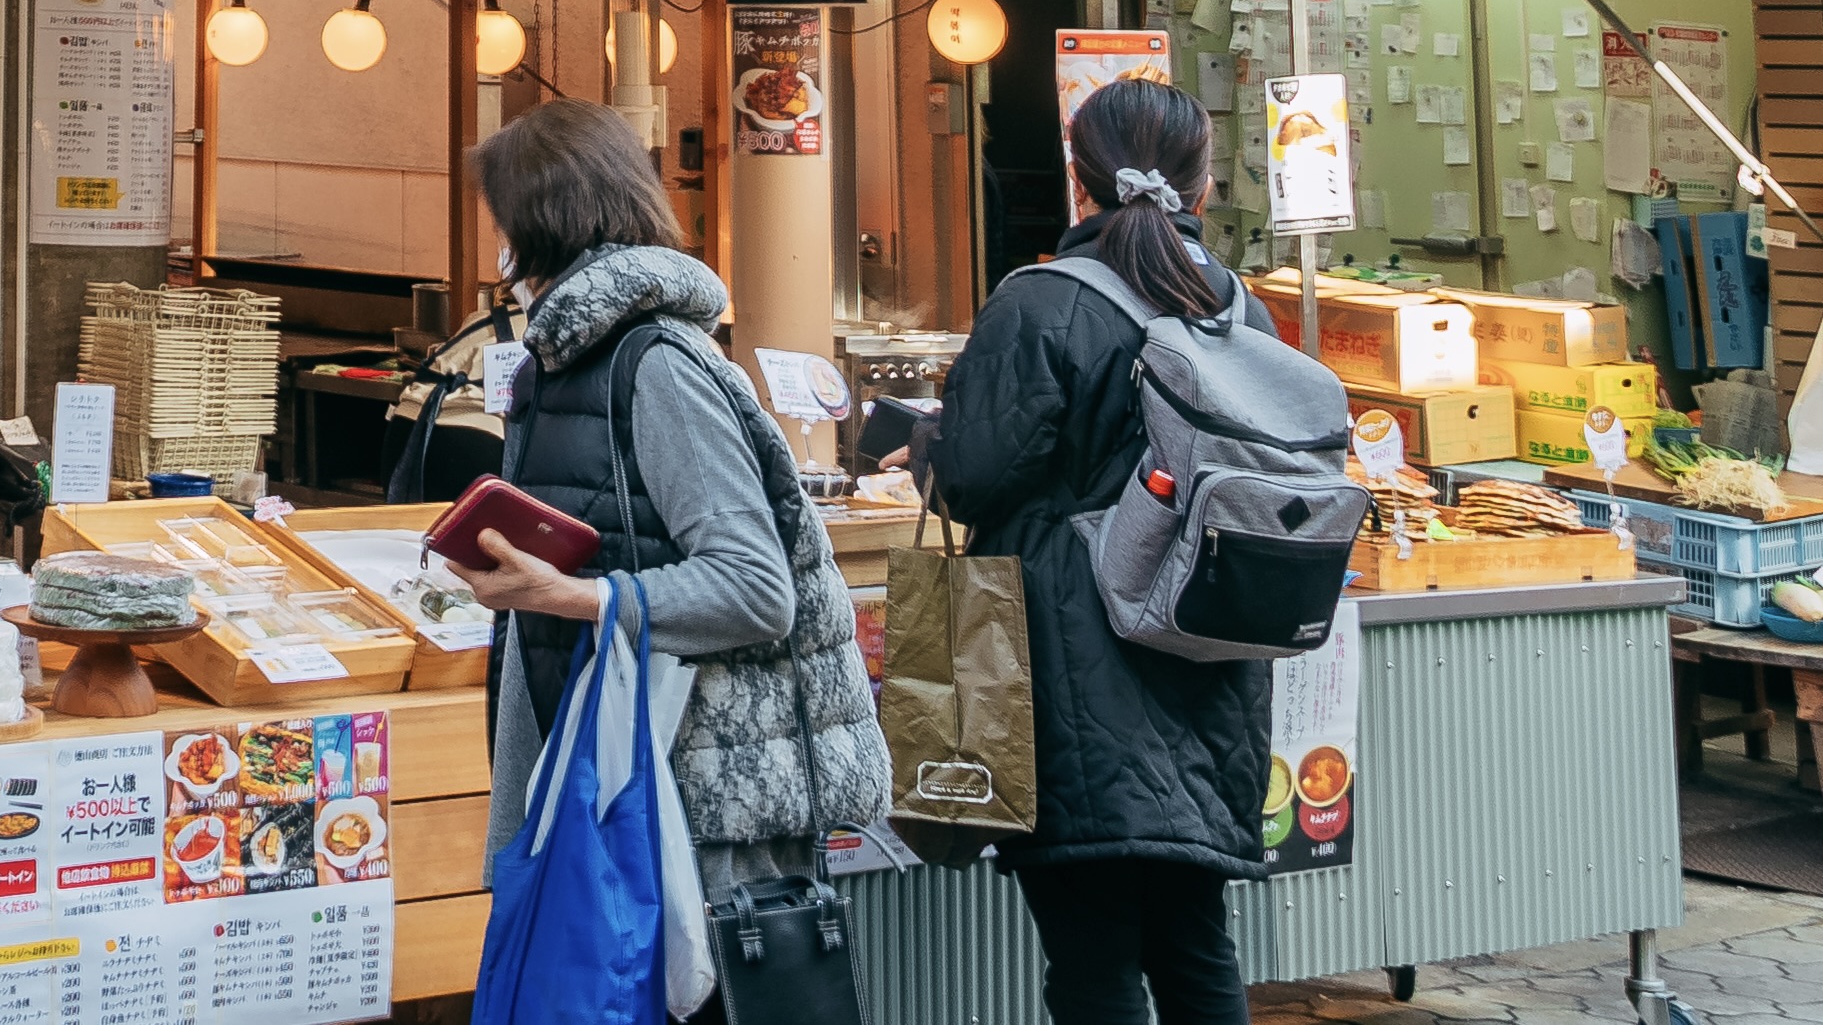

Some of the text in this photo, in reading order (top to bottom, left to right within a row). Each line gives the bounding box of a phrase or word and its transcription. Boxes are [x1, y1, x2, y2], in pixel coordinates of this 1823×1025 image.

[81, 773, 137, 797] お一人様
[60, 815, 156, 844] イートイン可能
[226, 918, 251, 938] 김밥
